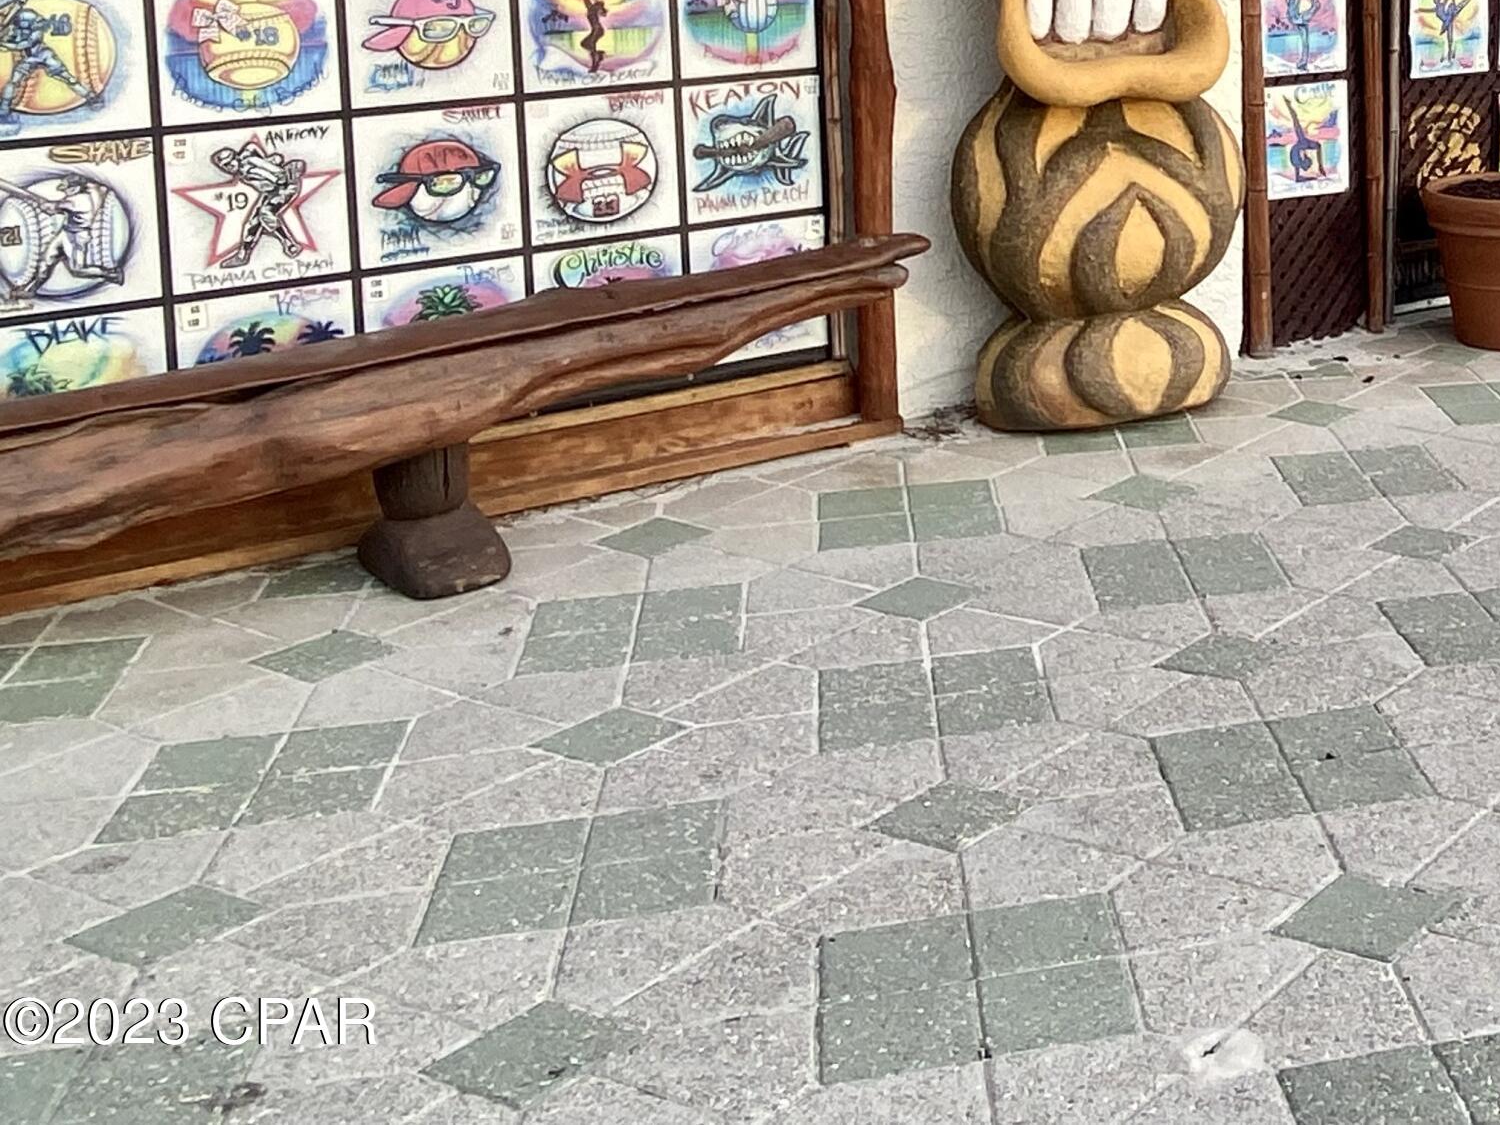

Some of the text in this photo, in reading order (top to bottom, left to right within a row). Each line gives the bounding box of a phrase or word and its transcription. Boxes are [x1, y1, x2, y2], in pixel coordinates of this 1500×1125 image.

[688, 80, 801, 119] KEATON
[762, 179, 811, 208] BEACH
[189, 267, 258, 290] PANAMA
[552, 240, 665, 290] Christie
[17, 316, 125, 356] BLAKE
